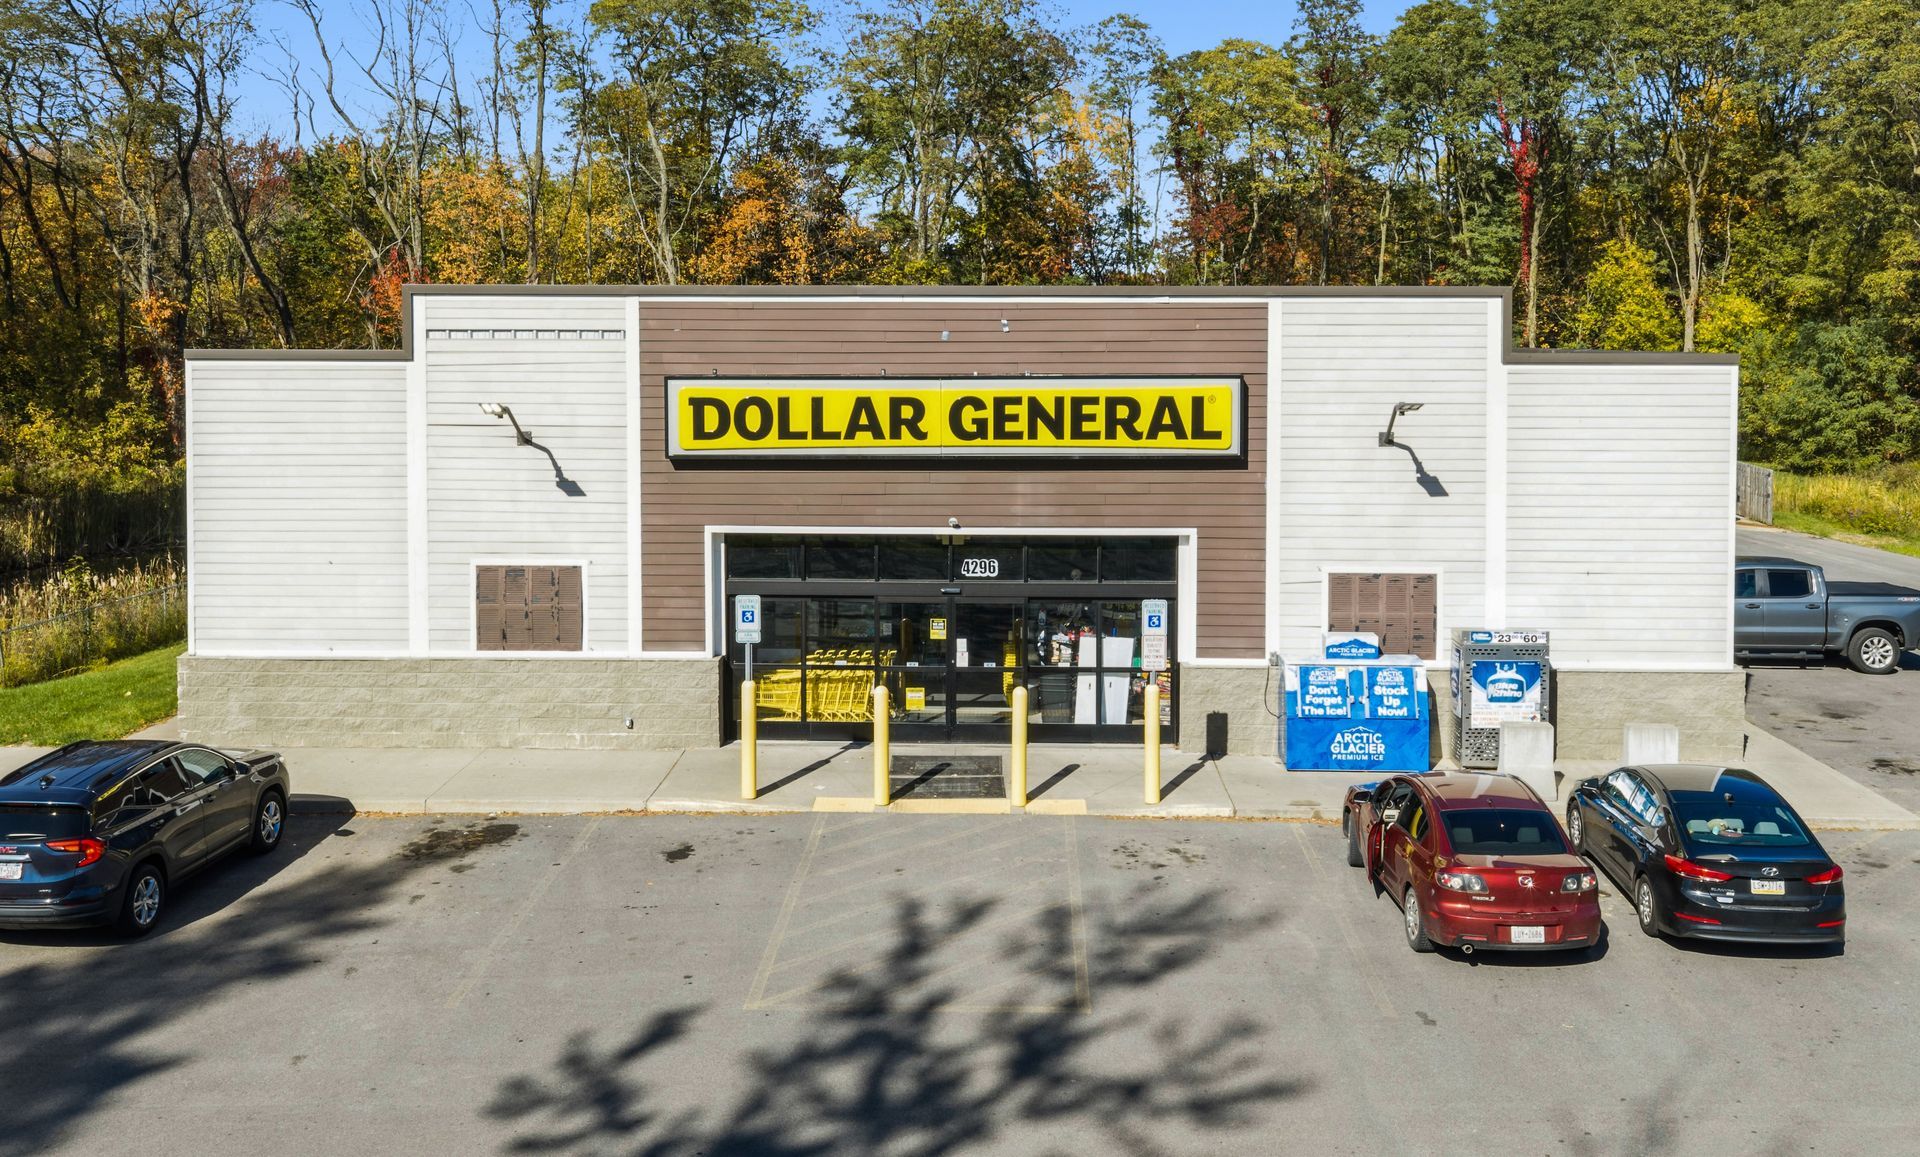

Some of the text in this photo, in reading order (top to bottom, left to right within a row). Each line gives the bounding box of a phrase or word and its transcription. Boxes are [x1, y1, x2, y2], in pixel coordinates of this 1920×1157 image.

[688, 396, 1222, 441] DOLLAR GENERAL
[961, 559, 998, 577] 4296
[1309, 685, 1338, 695] Don't
[1373, 685, 1408, 696] Stock
[1495, 682, 1518, 690] Blue
[1494, 689, 1522, 698] Rhino
[1305, 695, 1342, 706] Forget
[1383, 696, 1401, 707] Up
[1302, 706, 1347, 716] The Ice!
[1377, 707, 1408, 716] Now!
[1334, 733, 1383, 743] ARCTIC
[1330, 743, 1386, 754] GLACIER
